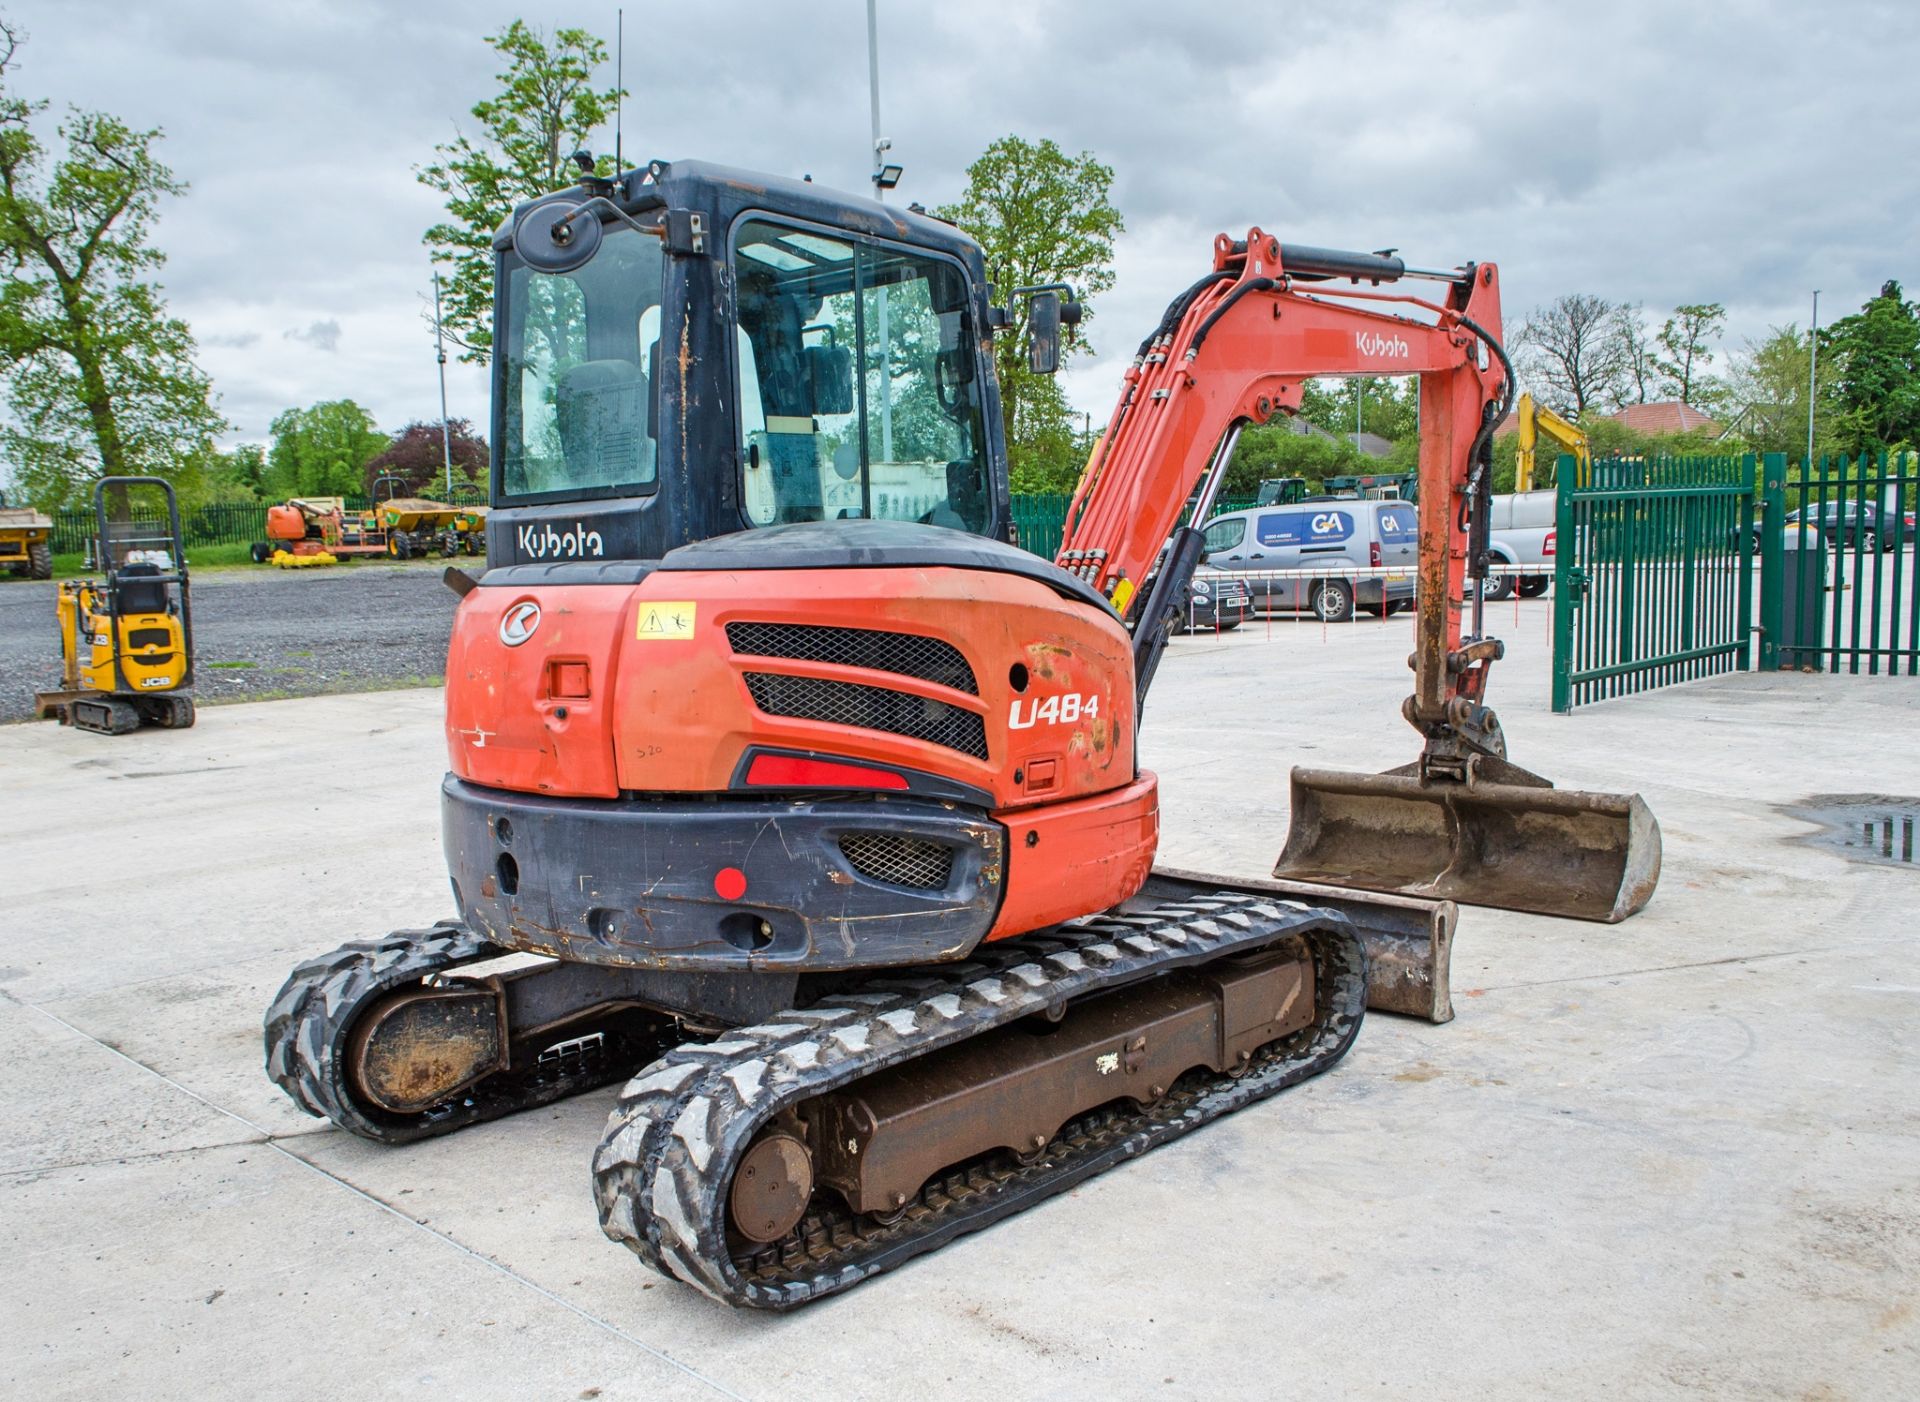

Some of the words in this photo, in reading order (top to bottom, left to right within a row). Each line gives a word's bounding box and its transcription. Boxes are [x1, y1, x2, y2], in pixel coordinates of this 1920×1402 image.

[1355, 331, 1409, 358] Kubota
[518, 522, 604, 558] Kubota
[141, 676, 171, 687] JCB
[1008, 692, 1099, 729] U48-4
